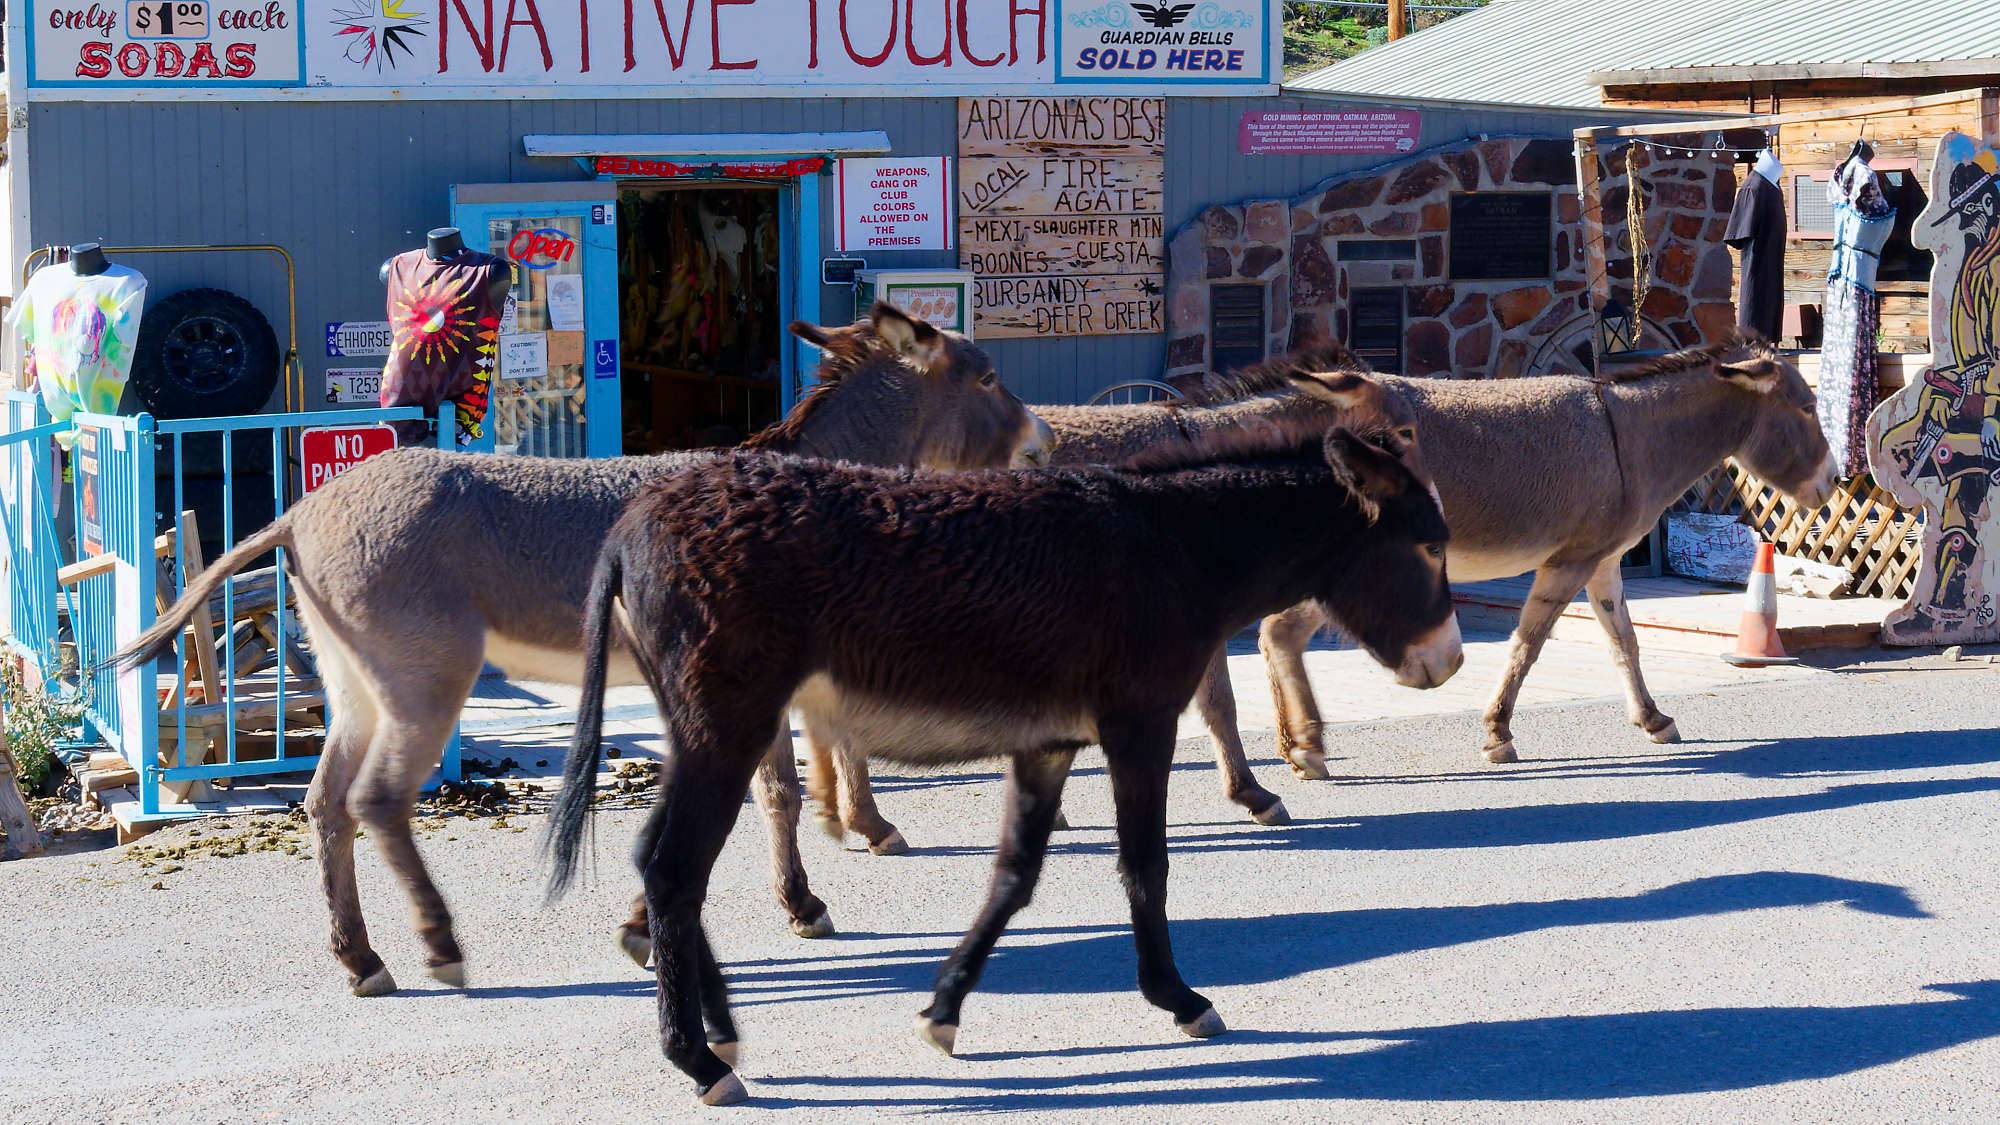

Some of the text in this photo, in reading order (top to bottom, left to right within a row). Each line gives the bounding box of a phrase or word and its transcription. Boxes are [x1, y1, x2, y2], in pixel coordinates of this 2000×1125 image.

[50, 8, 118, 37] only
[218, 1, 289, 30] each
[1100, 30, 1233, 46] GUARDIAN BELLS
[75, 41, 256, 78] SODAS
[1076, 47, 1244, 71] SOLD HERE
[1113, 98, 1165, 142] BEST
[1371, 113, 1396, 121] ARIZONA
[876, 168, 930, 177] WEAPONS,
[870, 179, 918, 189] GANG OR
[962, 159, 1116, 210] LOCAL FIRE
[880, 191, 908, 200] CLUB
[873, 202, 915, 211] COLORS
[859, 213, 928, 223] ALLOWED ON
[875, 226, 895, 234] THE
[1130, 217, 1162, 238] MTN
[509, 230, 575, 262] Open
[868, 236, 921, 246] PREMISES
[1104, 301, 1161, 330] CREEK
[335, 434, 363, 459] NO
